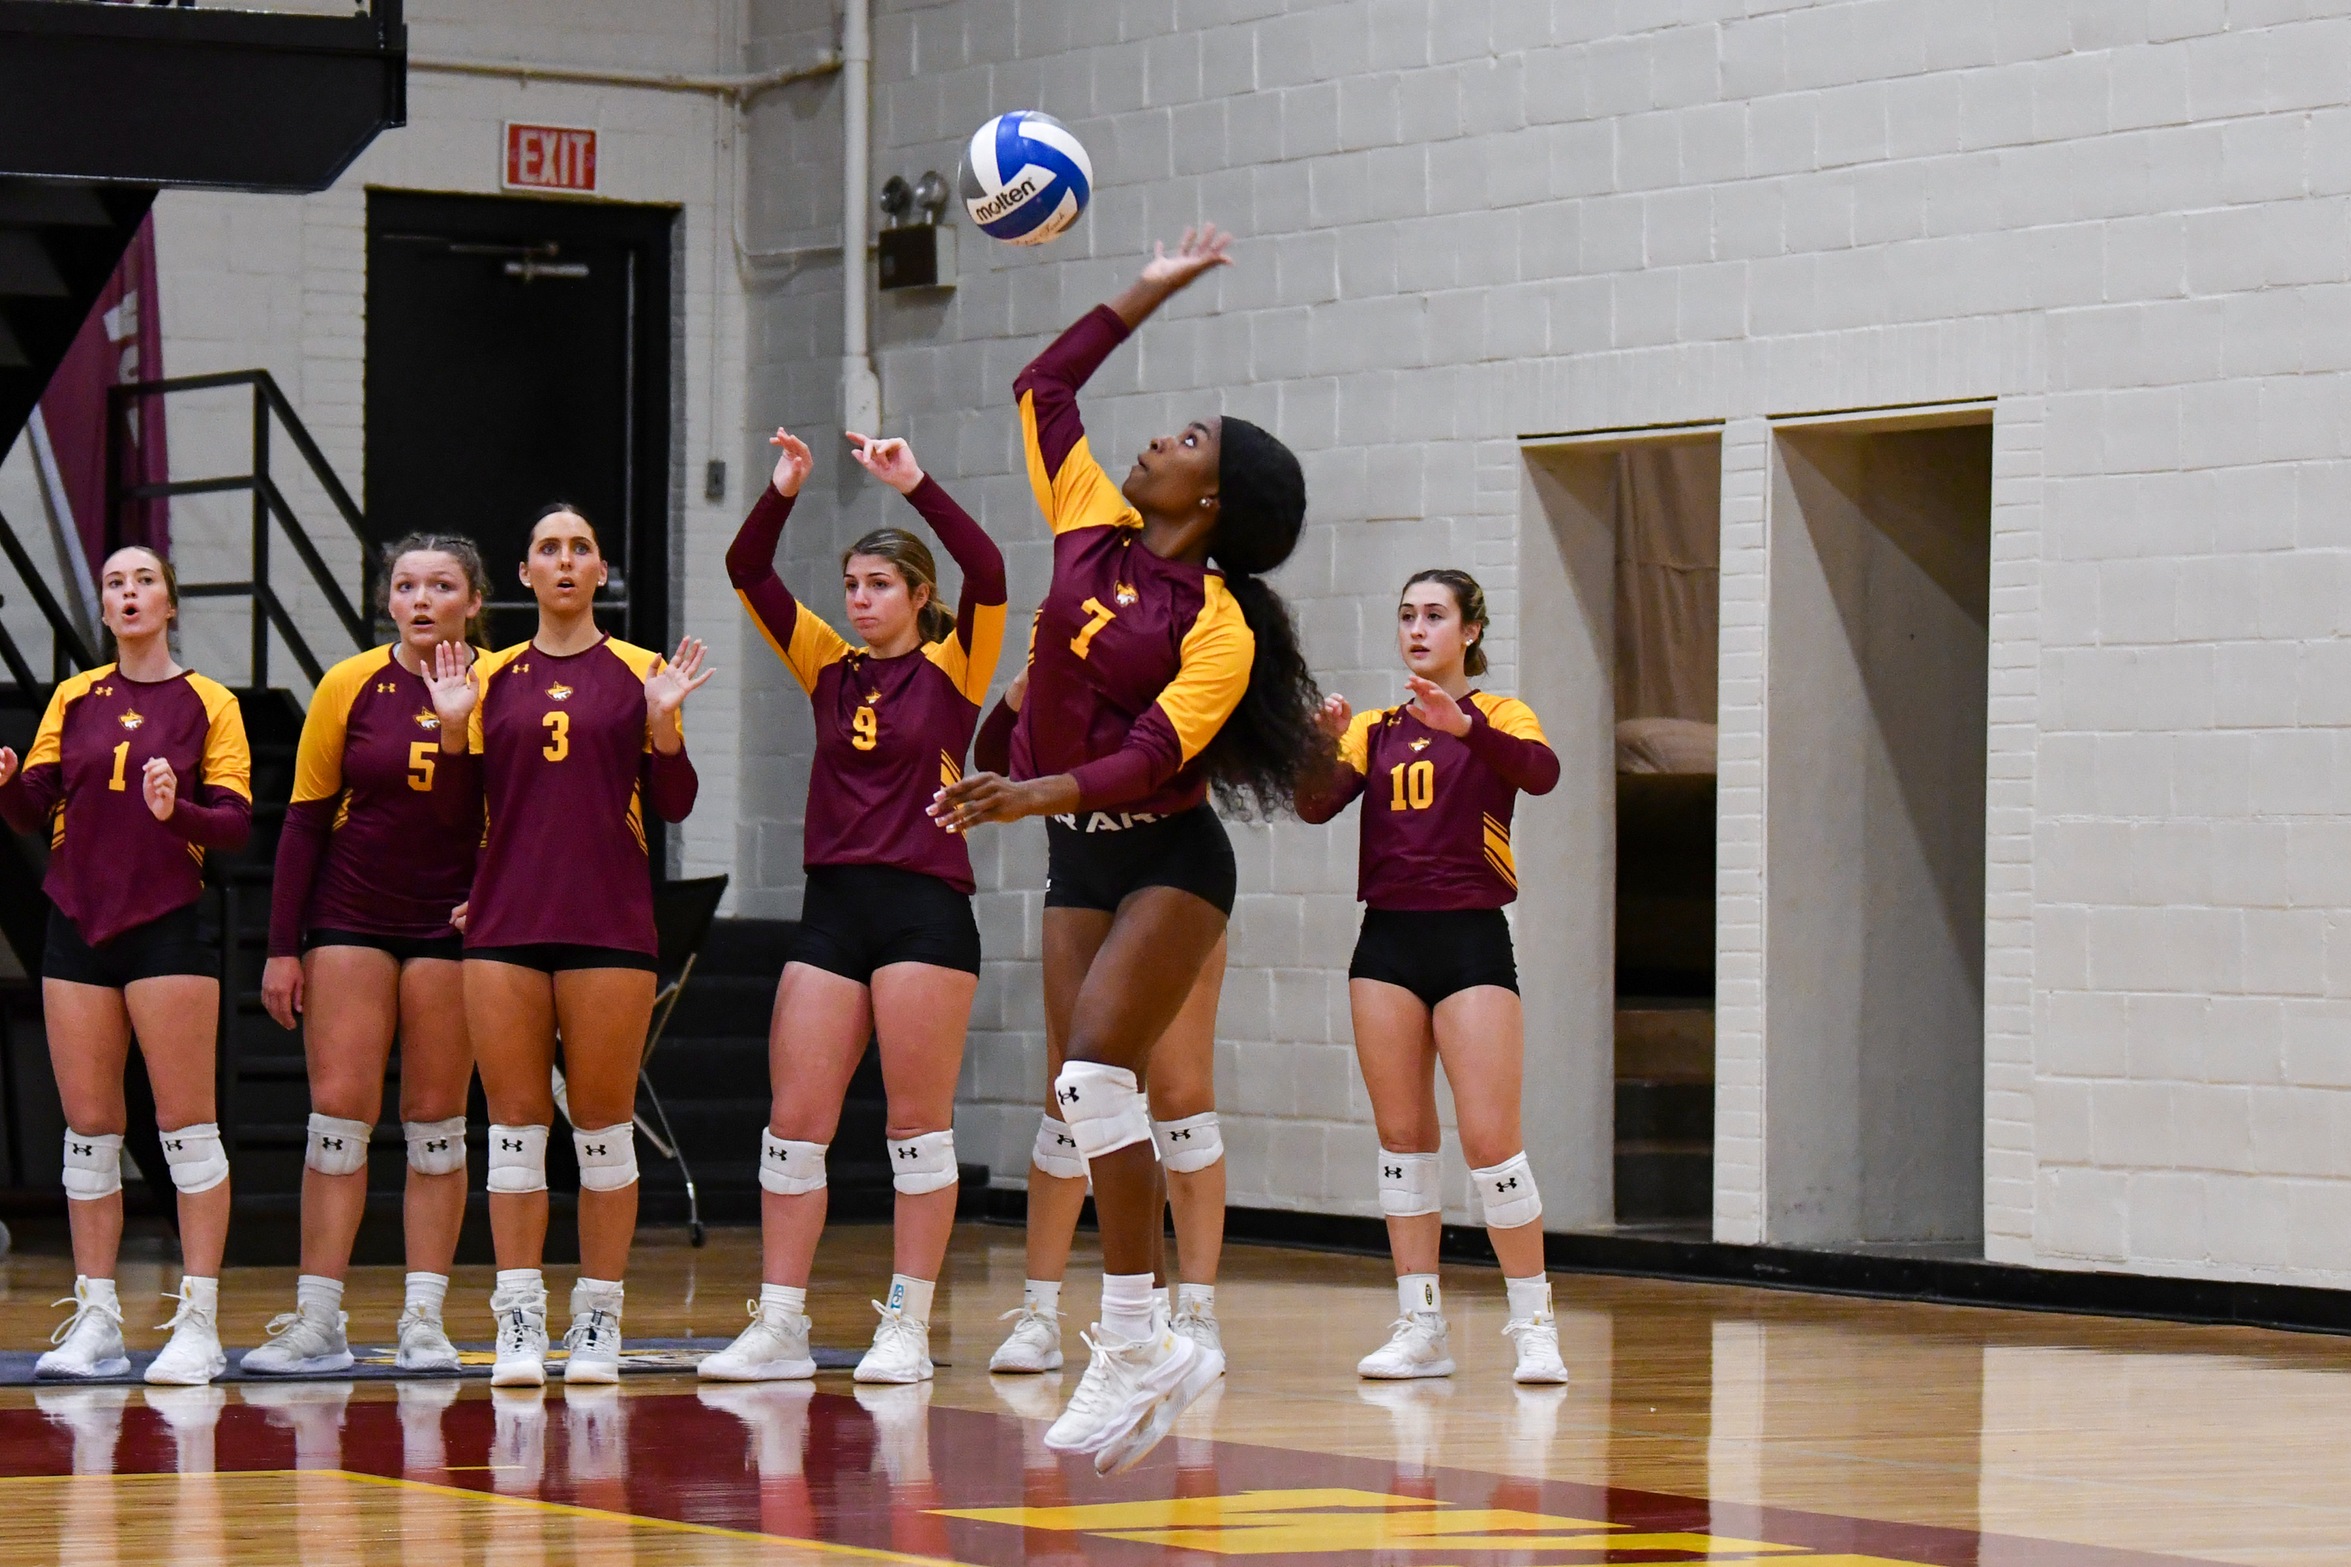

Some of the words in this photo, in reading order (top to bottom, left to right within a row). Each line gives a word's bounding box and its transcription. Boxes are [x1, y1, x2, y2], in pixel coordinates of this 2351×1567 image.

[519, 128, 592, 187] EXIT
[975, 179, 1036, 221] molten
[1069, 597, 1116, 660] 7
[542, 710, 570, 762] 3
[851, 705, 878, 751] 9
[108, 740, 130, 792] 1
[407, 741, 439, 792] 5
[1390, 759, 1435, 811] 10
